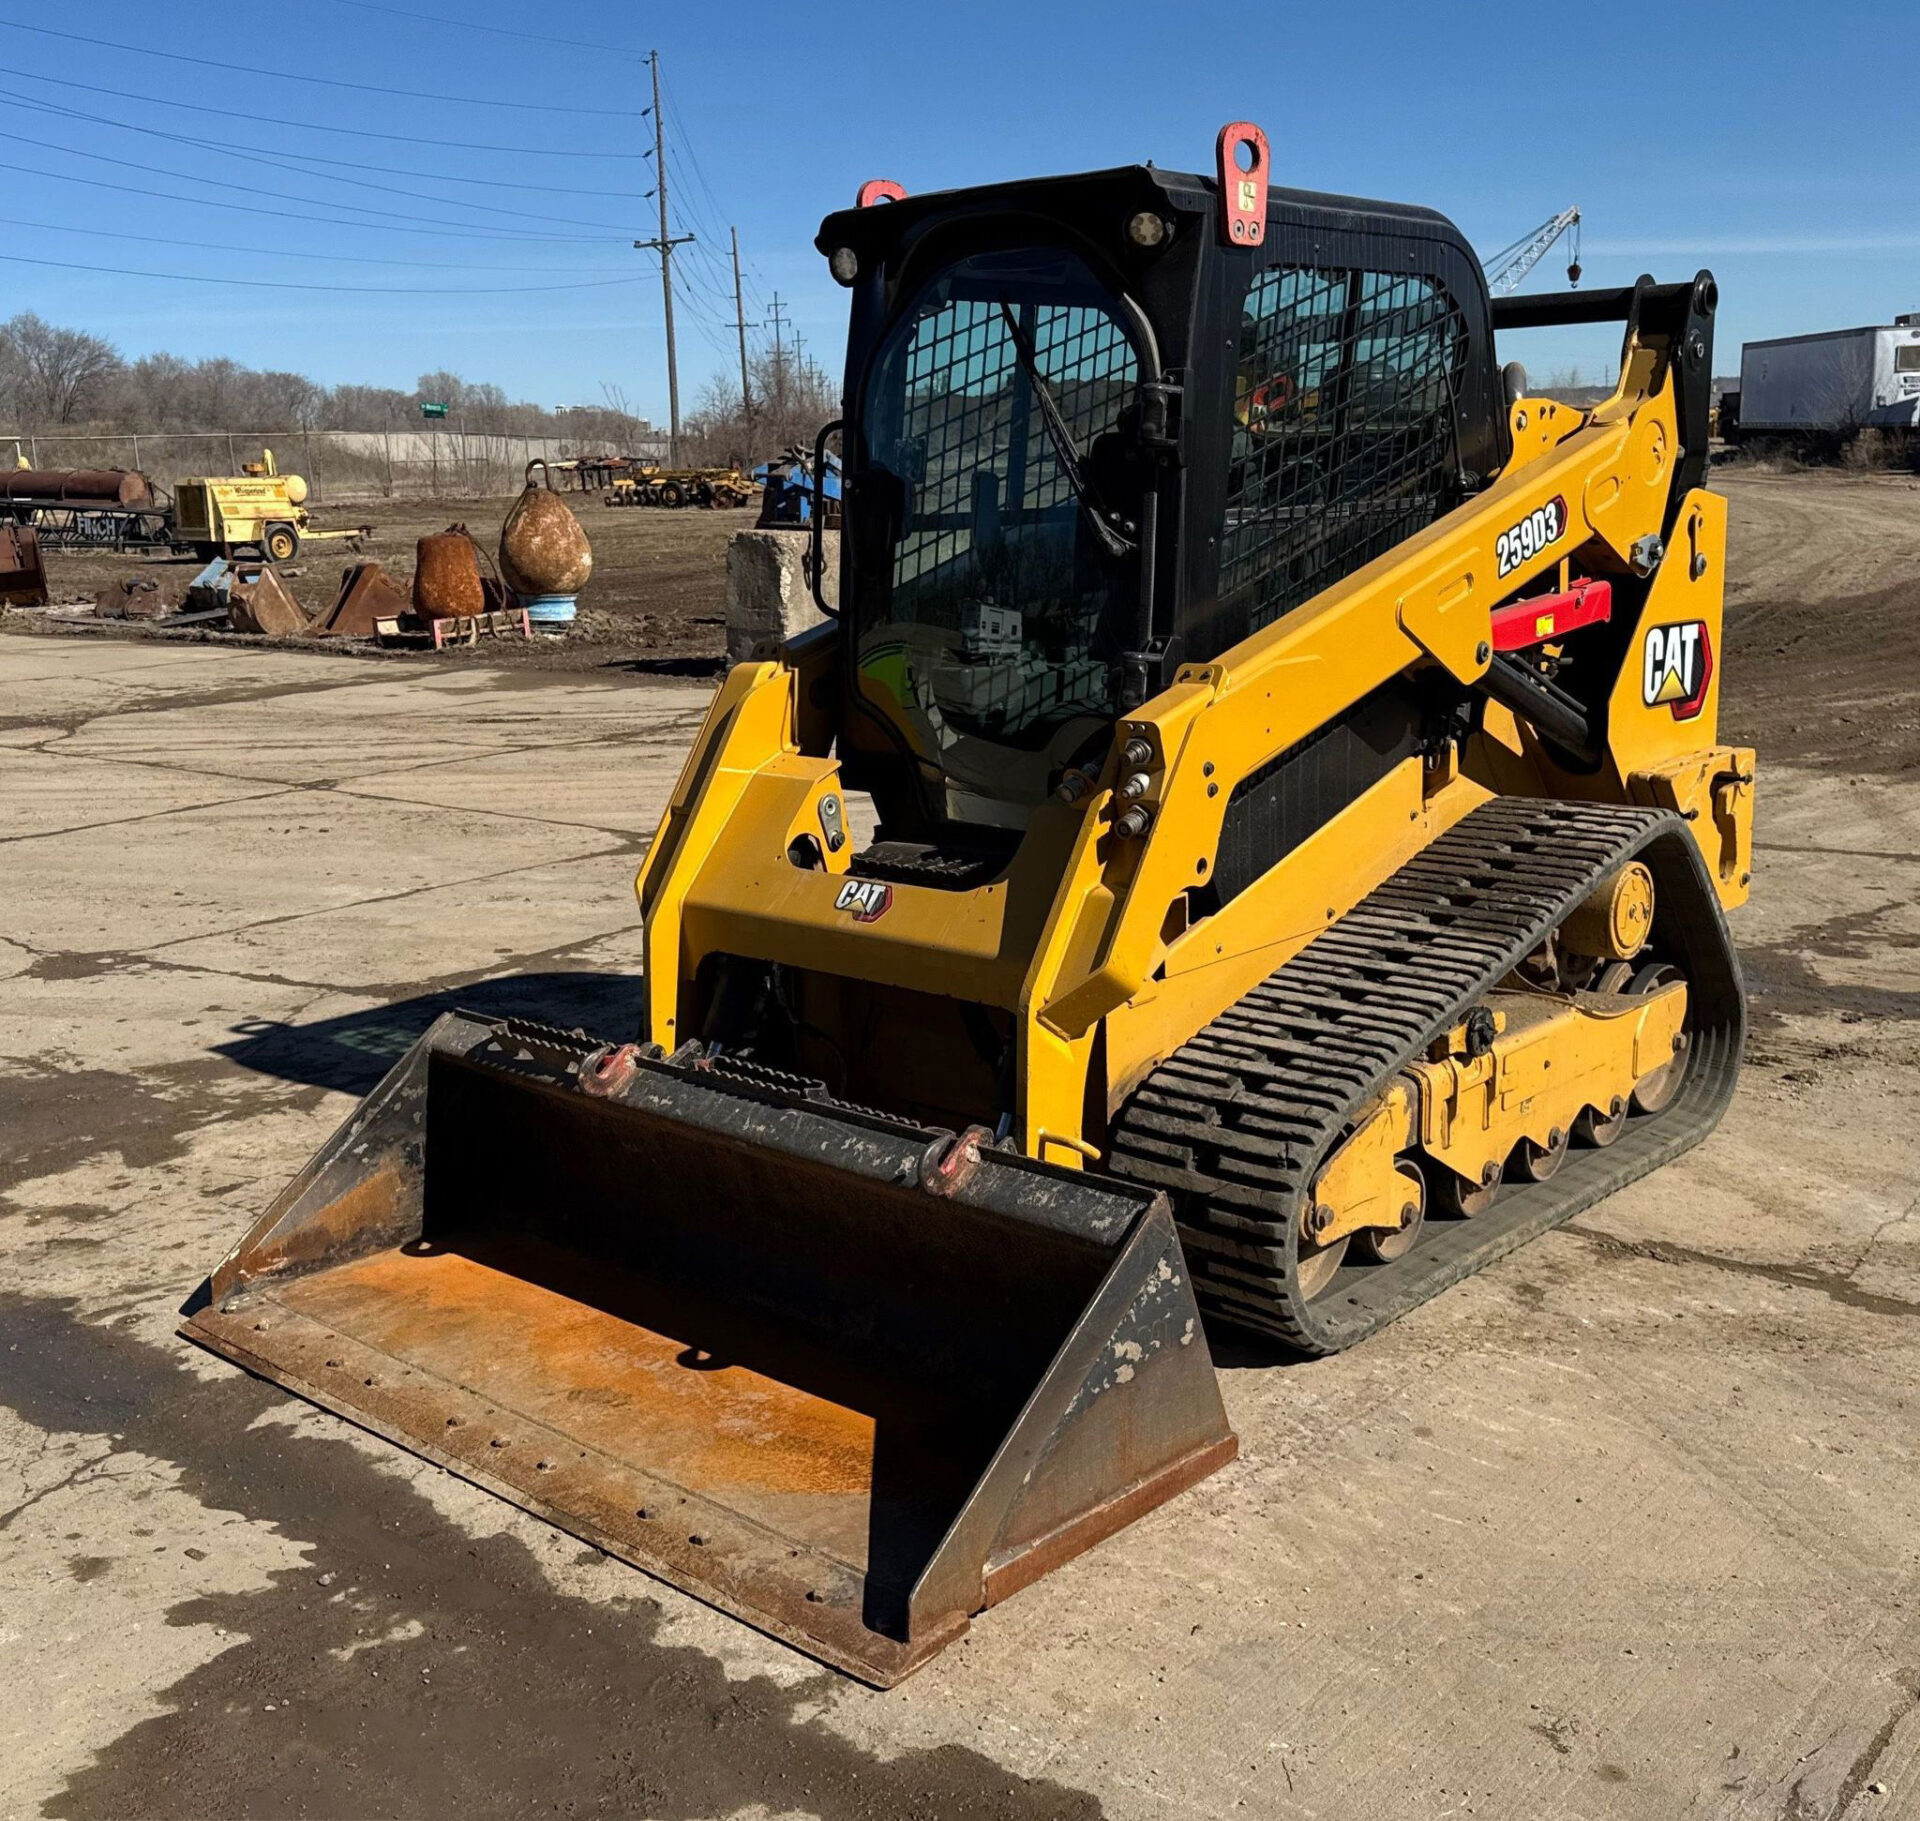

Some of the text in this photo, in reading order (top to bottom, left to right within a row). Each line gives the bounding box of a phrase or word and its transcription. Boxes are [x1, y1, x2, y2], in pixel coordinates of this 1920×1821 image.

[77, 517, 116, 536] FINCH
[1496, 502, 1558, 577] 259D3
[1645, 623, 1699, 704] CAT
[835, 880, 887, 913] CAT
